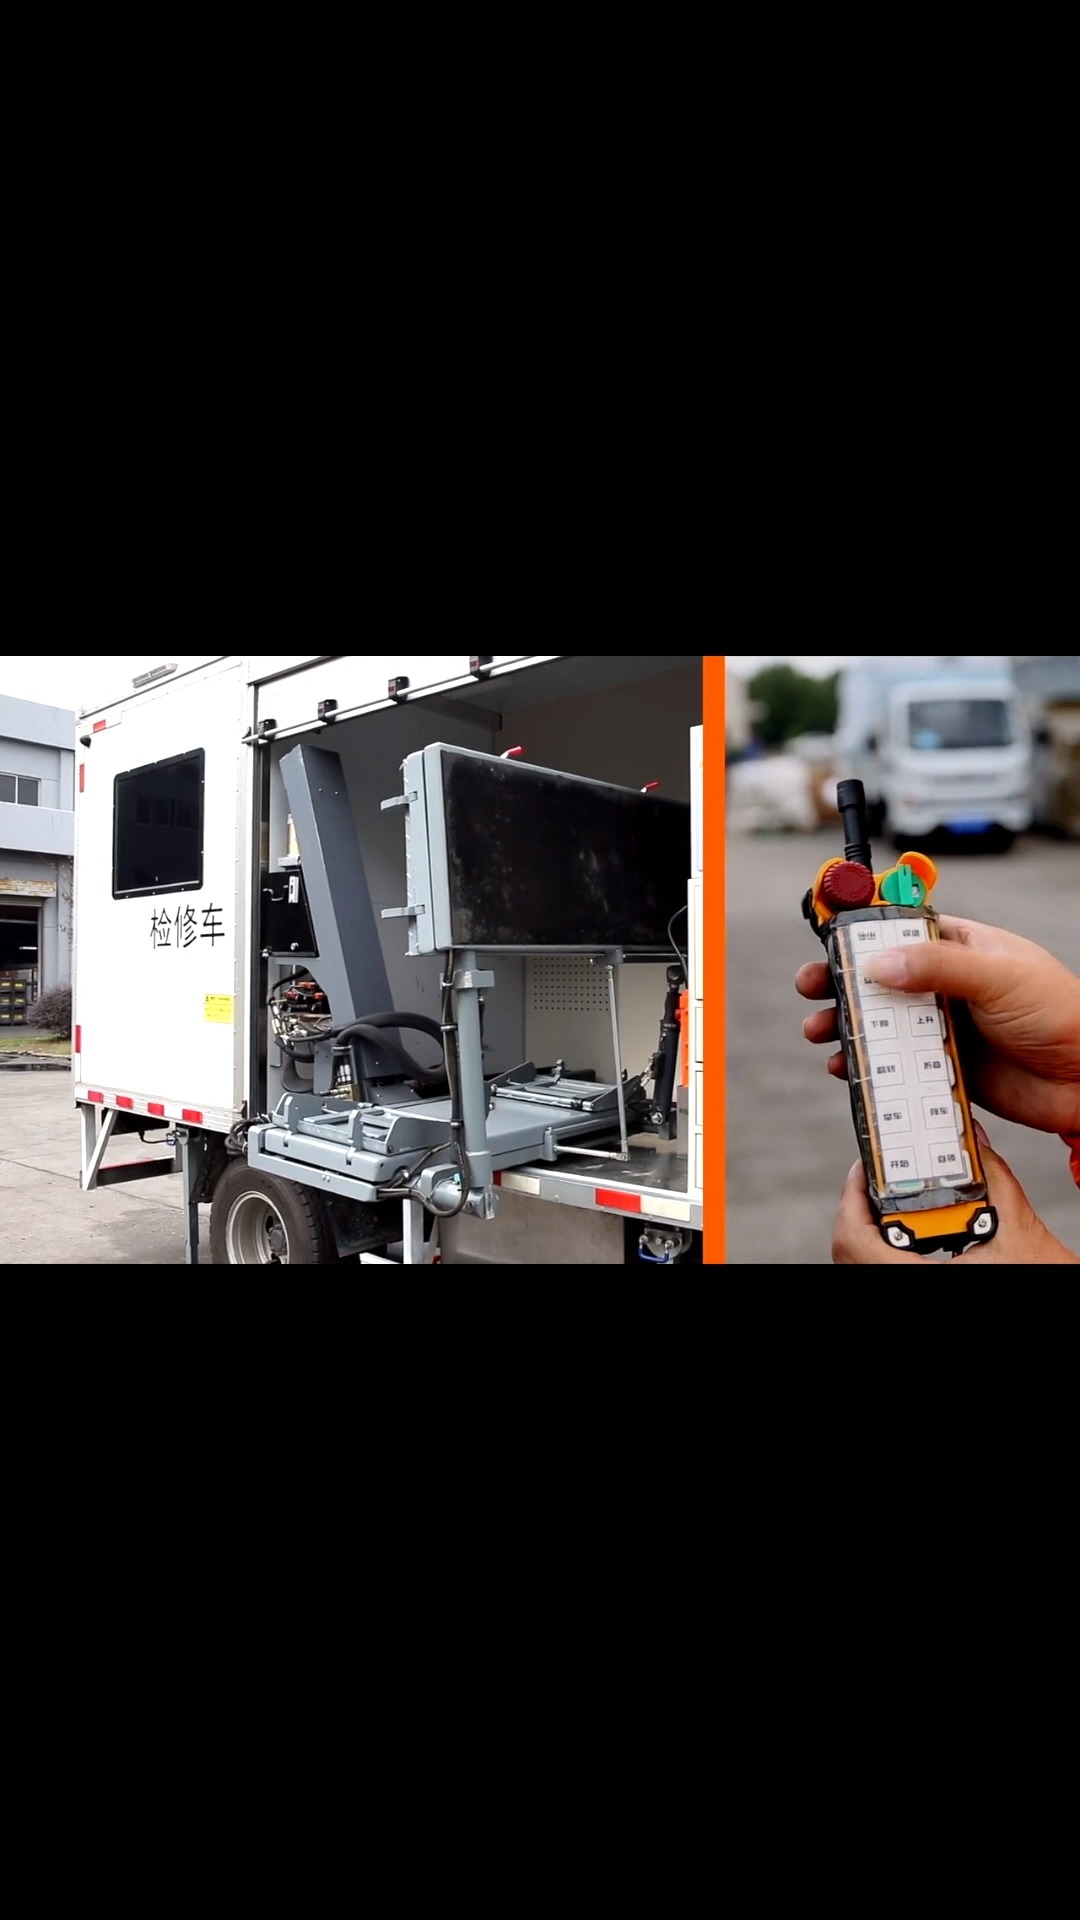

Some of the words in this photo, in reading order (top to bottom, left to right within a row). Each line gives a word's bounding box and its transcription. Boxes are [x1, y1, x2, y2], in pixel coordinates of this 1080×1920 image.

[150, 902, 225, 949] 检修车
[916, 1015, 935, 1025] 上升
[889, 1159, 910, 1170] 开始
